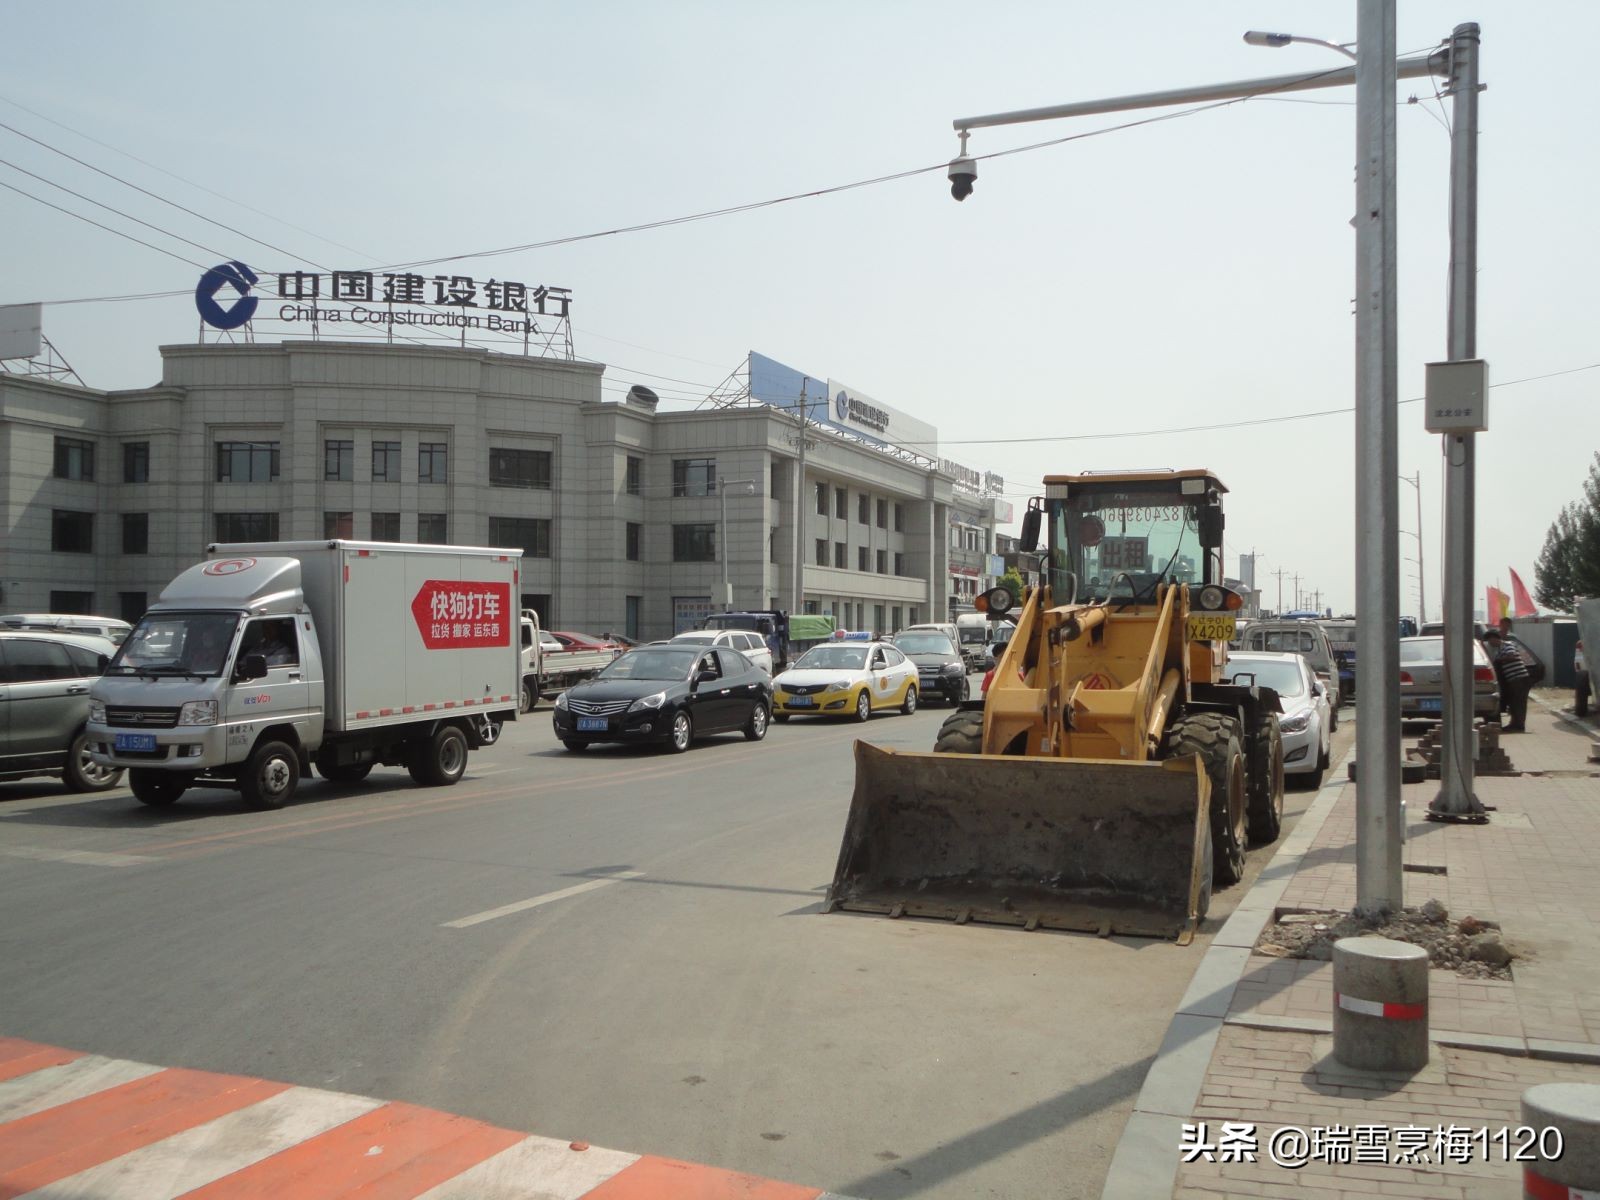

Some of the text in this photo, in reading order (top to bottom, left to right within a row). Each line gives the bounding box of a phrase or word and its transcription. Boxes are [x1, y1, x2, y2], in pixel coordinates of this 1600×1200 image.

[278, 270, 573, 317] 中国建设银行
[279, 304, 539, 335] China Construction Bank
[1103, 540, 1144, 568] 出租
[430, 591, 500, 620] 快狗打车
[431, 623, 500, 638] 拉货 搬家 运东西
[1190, 624, 1234, 640] X4209
